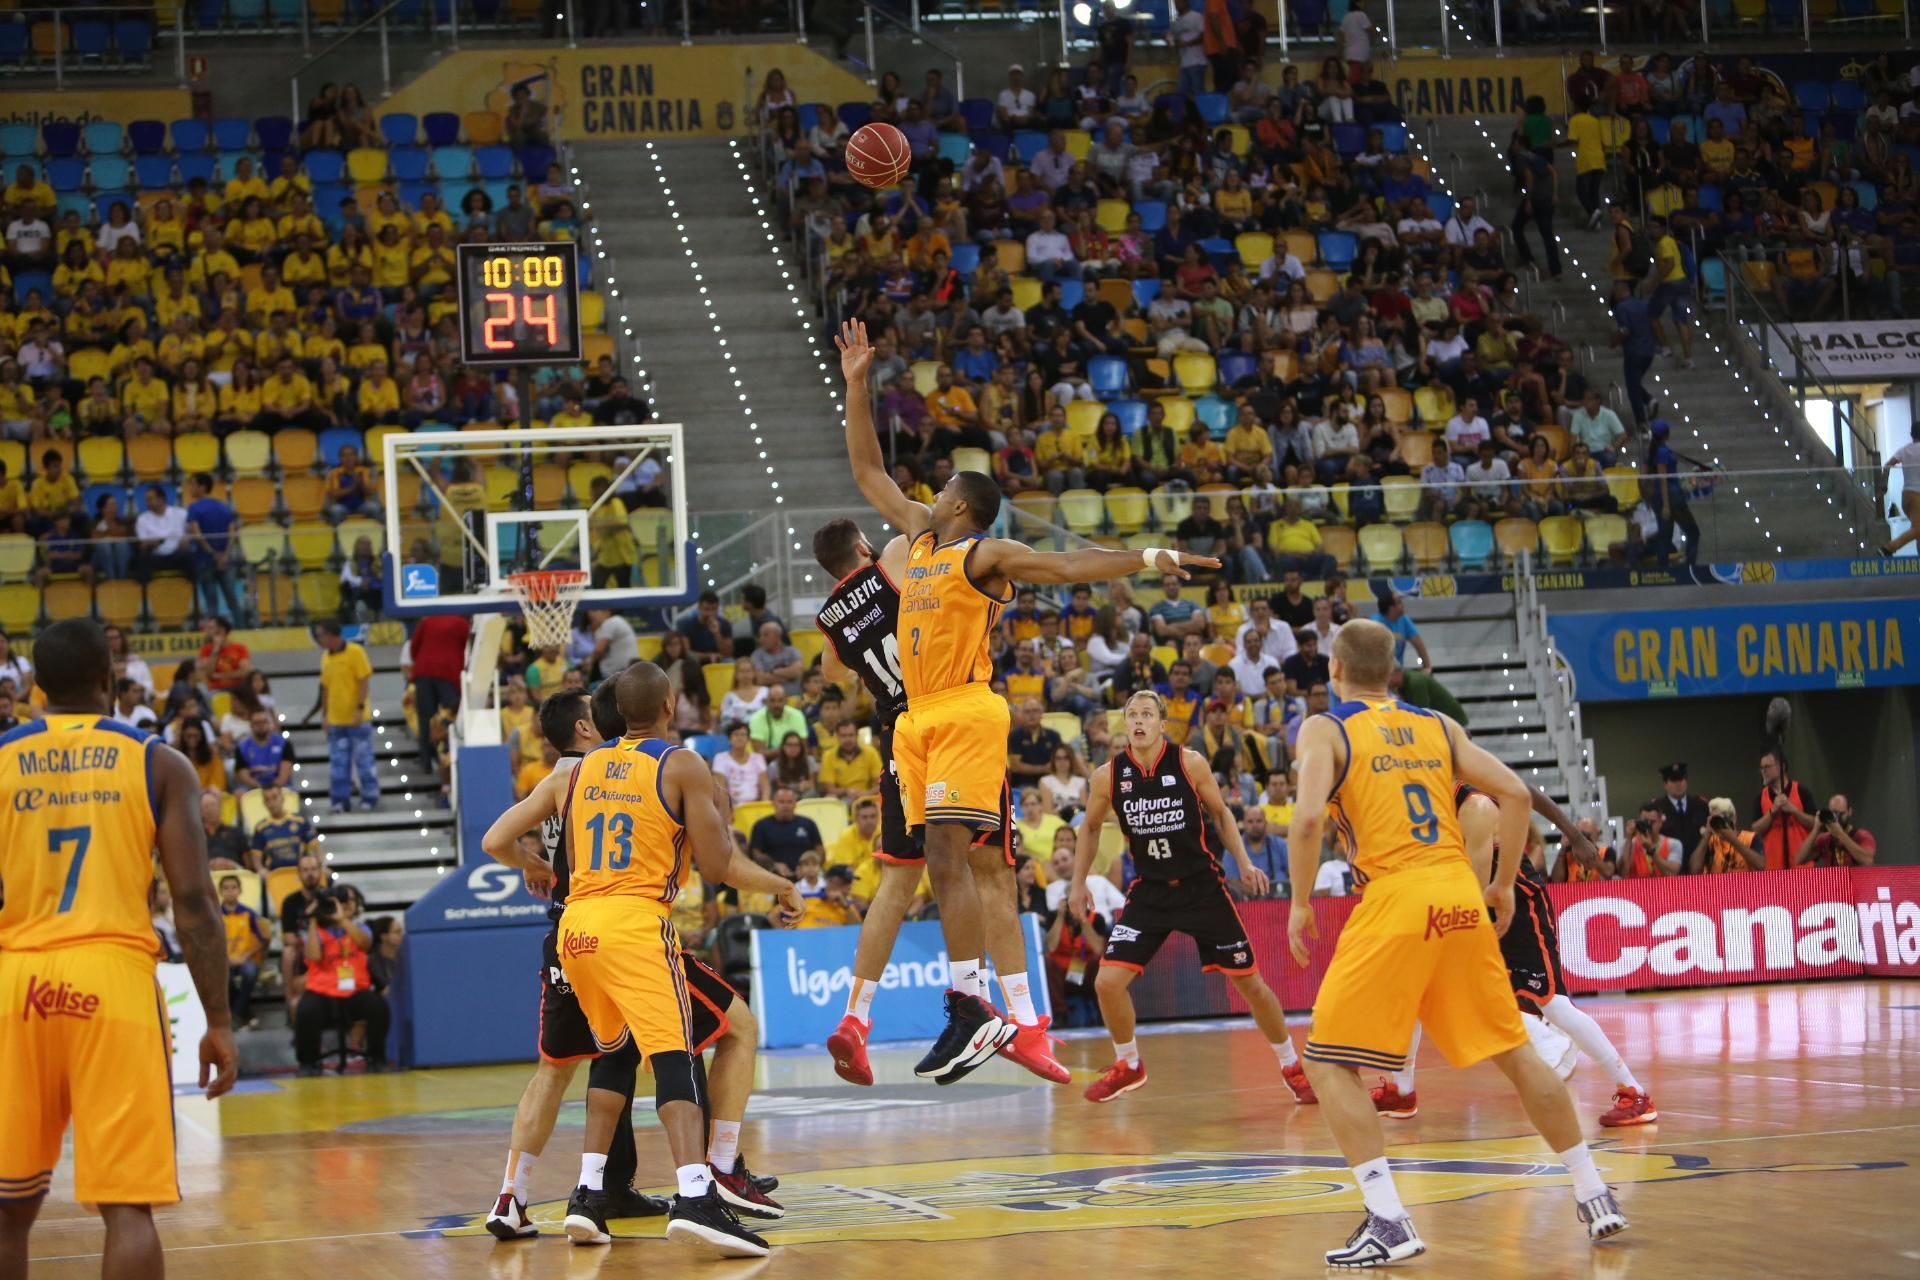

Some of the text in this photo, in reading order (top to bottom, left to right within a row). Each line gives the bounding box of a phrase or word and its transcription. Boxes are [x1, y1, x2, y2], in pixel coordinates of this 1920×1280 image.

[581, 64, 654, 97] GRAN
[1396, 76, 1526, 115] CANARIA
[583, 99, 703, 133] CANARIA
[484, 256, 563, 289] 10:00
[484, 293, 557, 350] 24
[1828, 351, 1895, 363] equipo
[905, 563, 952, 580] ERBALIFE
[1536, 573, 1584, 590] CANARIA
[1850, 559, 1879, 577] GRAN
[856, 603, 883, 632] isaval
[911, 627, 920, 656] 2
[1613, 625, 1718, 684] GRAN
[1736, 617, 1905, 677] CANARIA
[18, 746, 119, 776] McCALEBB
[1123, 797, 1183, 813] Cultura del
[1126, 809, 1184, 827] Esfuerzo
[1403, 783, 1439, 844] 9
[585, 812, 634, 870] 13
[1147, 838, 1172, 860] 43
[48, 825, 91, 912] 7
[502, 903, 547, 917] Sports
[1424, 905, 1480, 941] Kalise
[562, 928, 599, 960] Kalise
[787, 947, 851, 1006] liga
[23, 975, 99, 1021] Kalise
